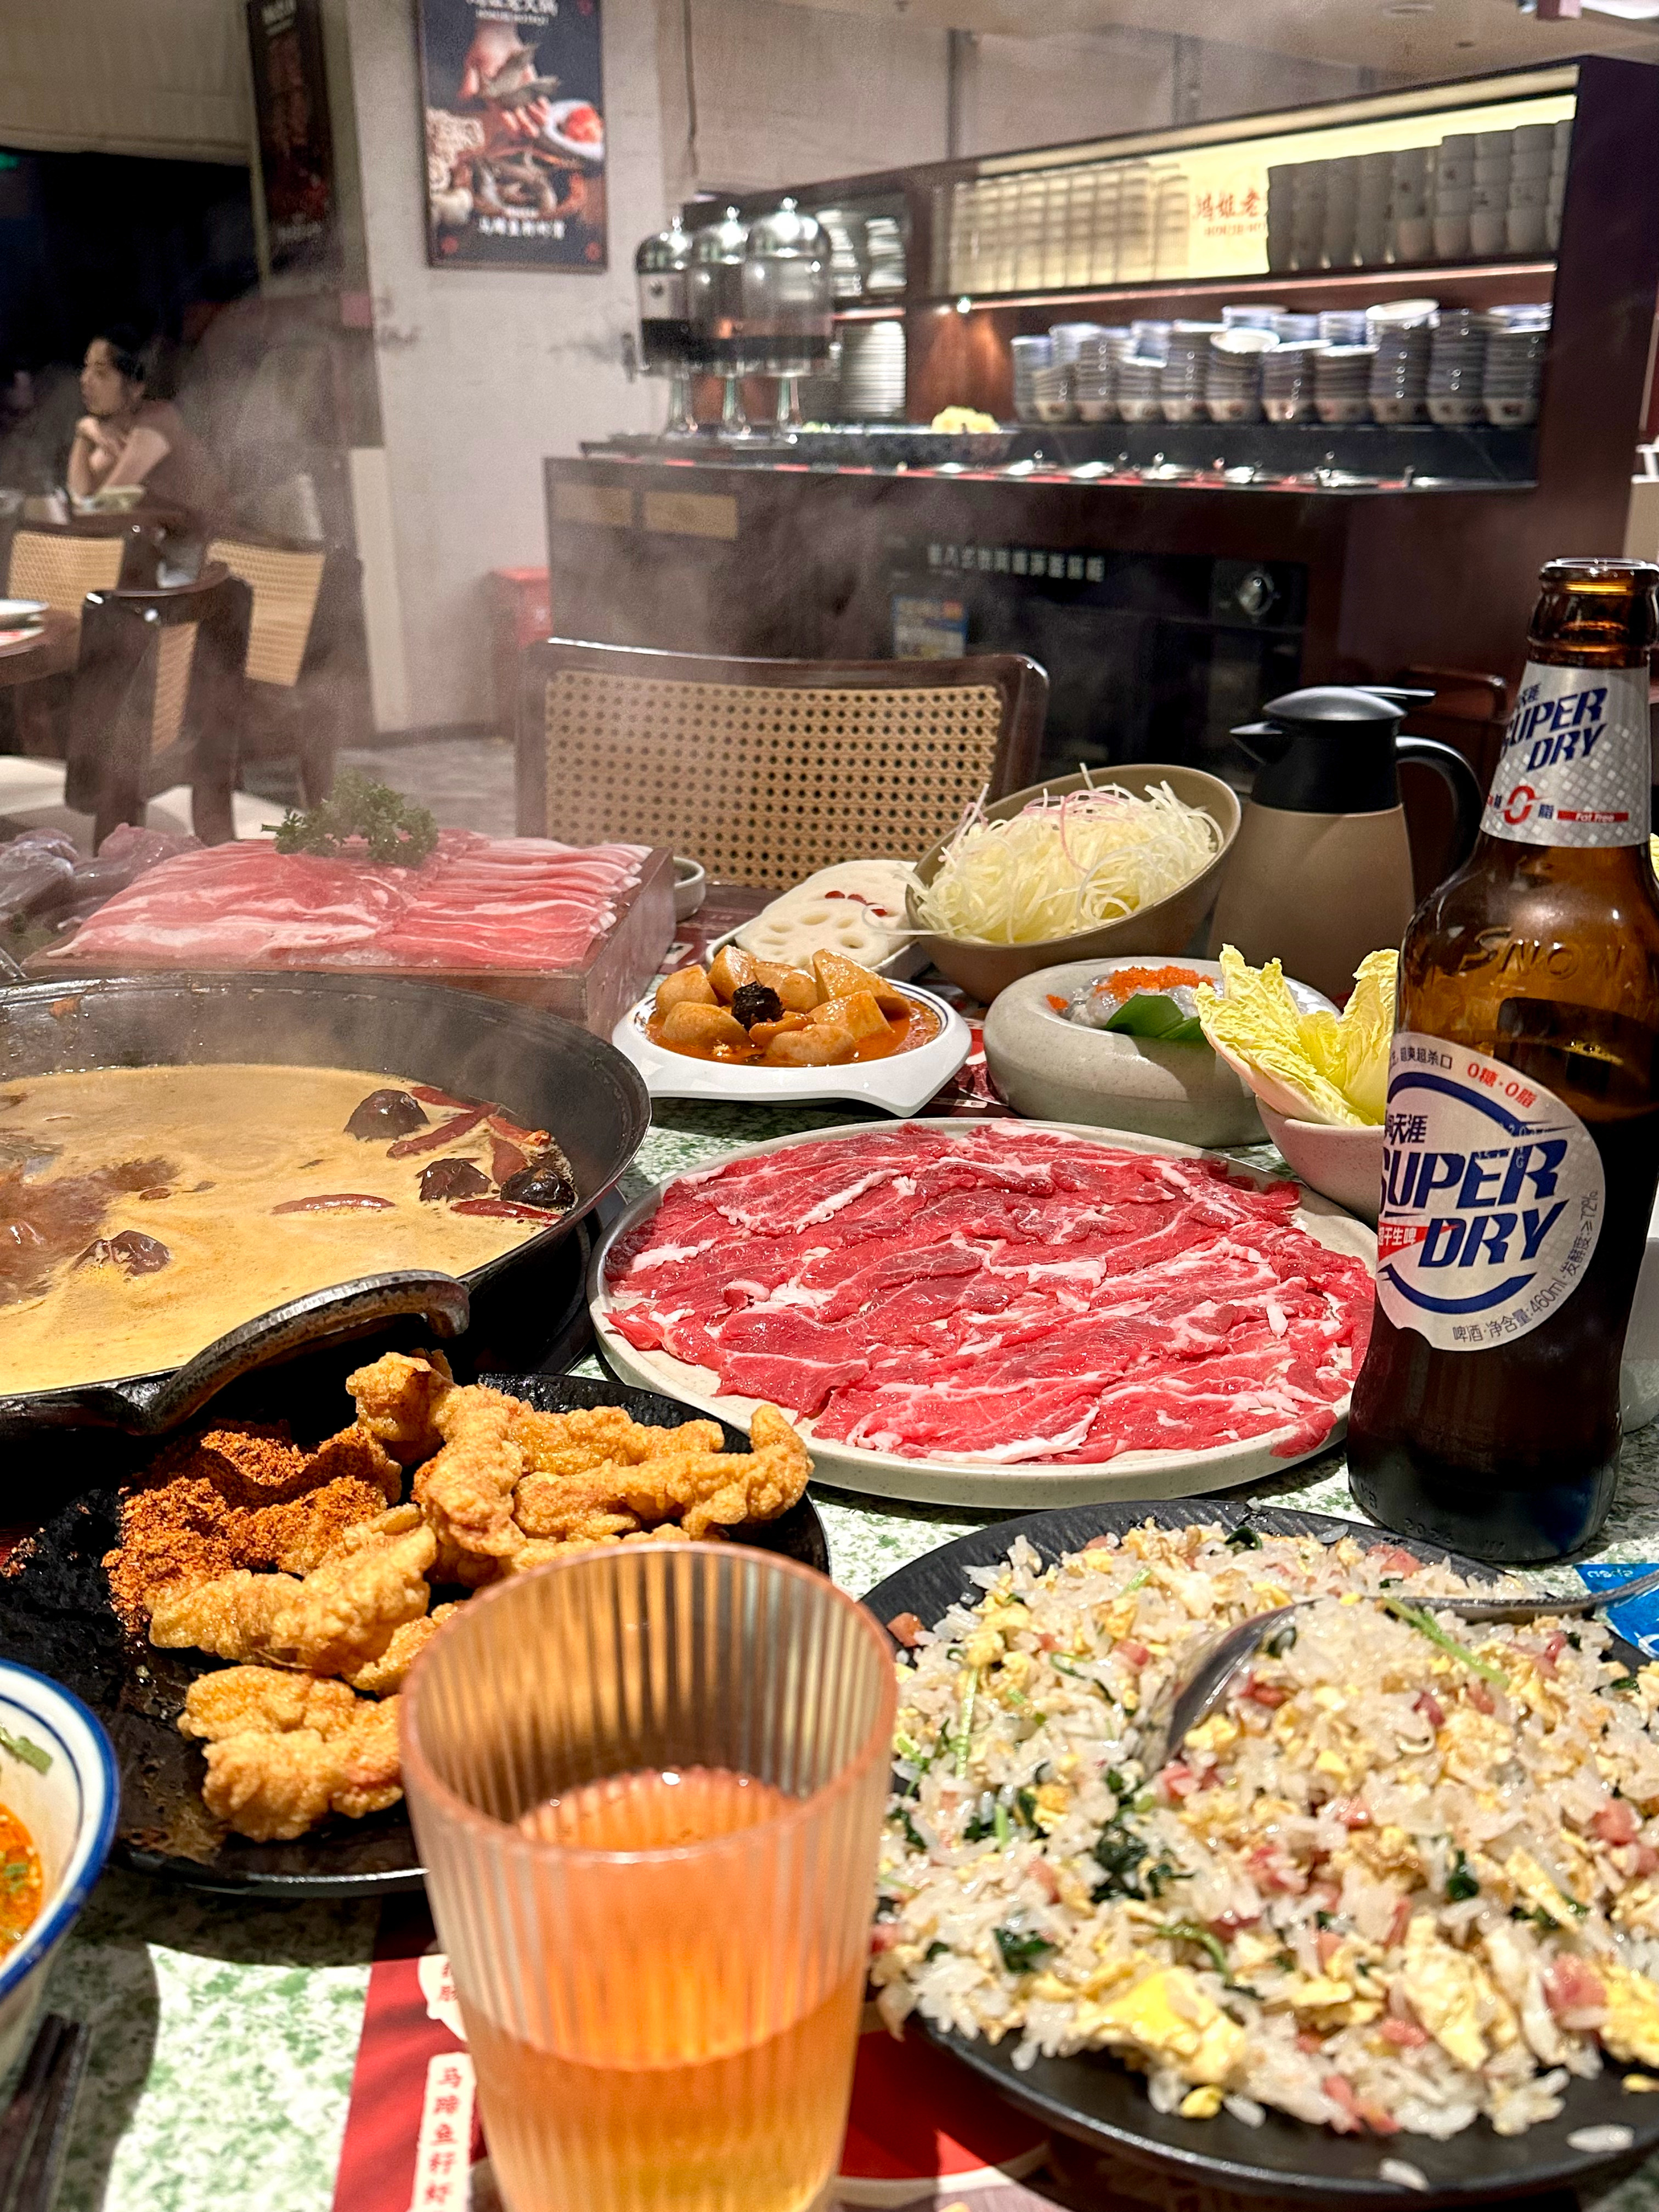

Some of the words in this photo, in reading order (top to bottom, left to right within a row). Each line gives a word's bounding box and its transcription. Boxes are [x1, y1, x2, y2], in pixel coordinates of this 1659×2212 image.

[1194, 188, 1268, 221] 鸿姐老
[1527, 723, 1607, 772] DRY
[1418, 1199, 1570, 1267] DRY
